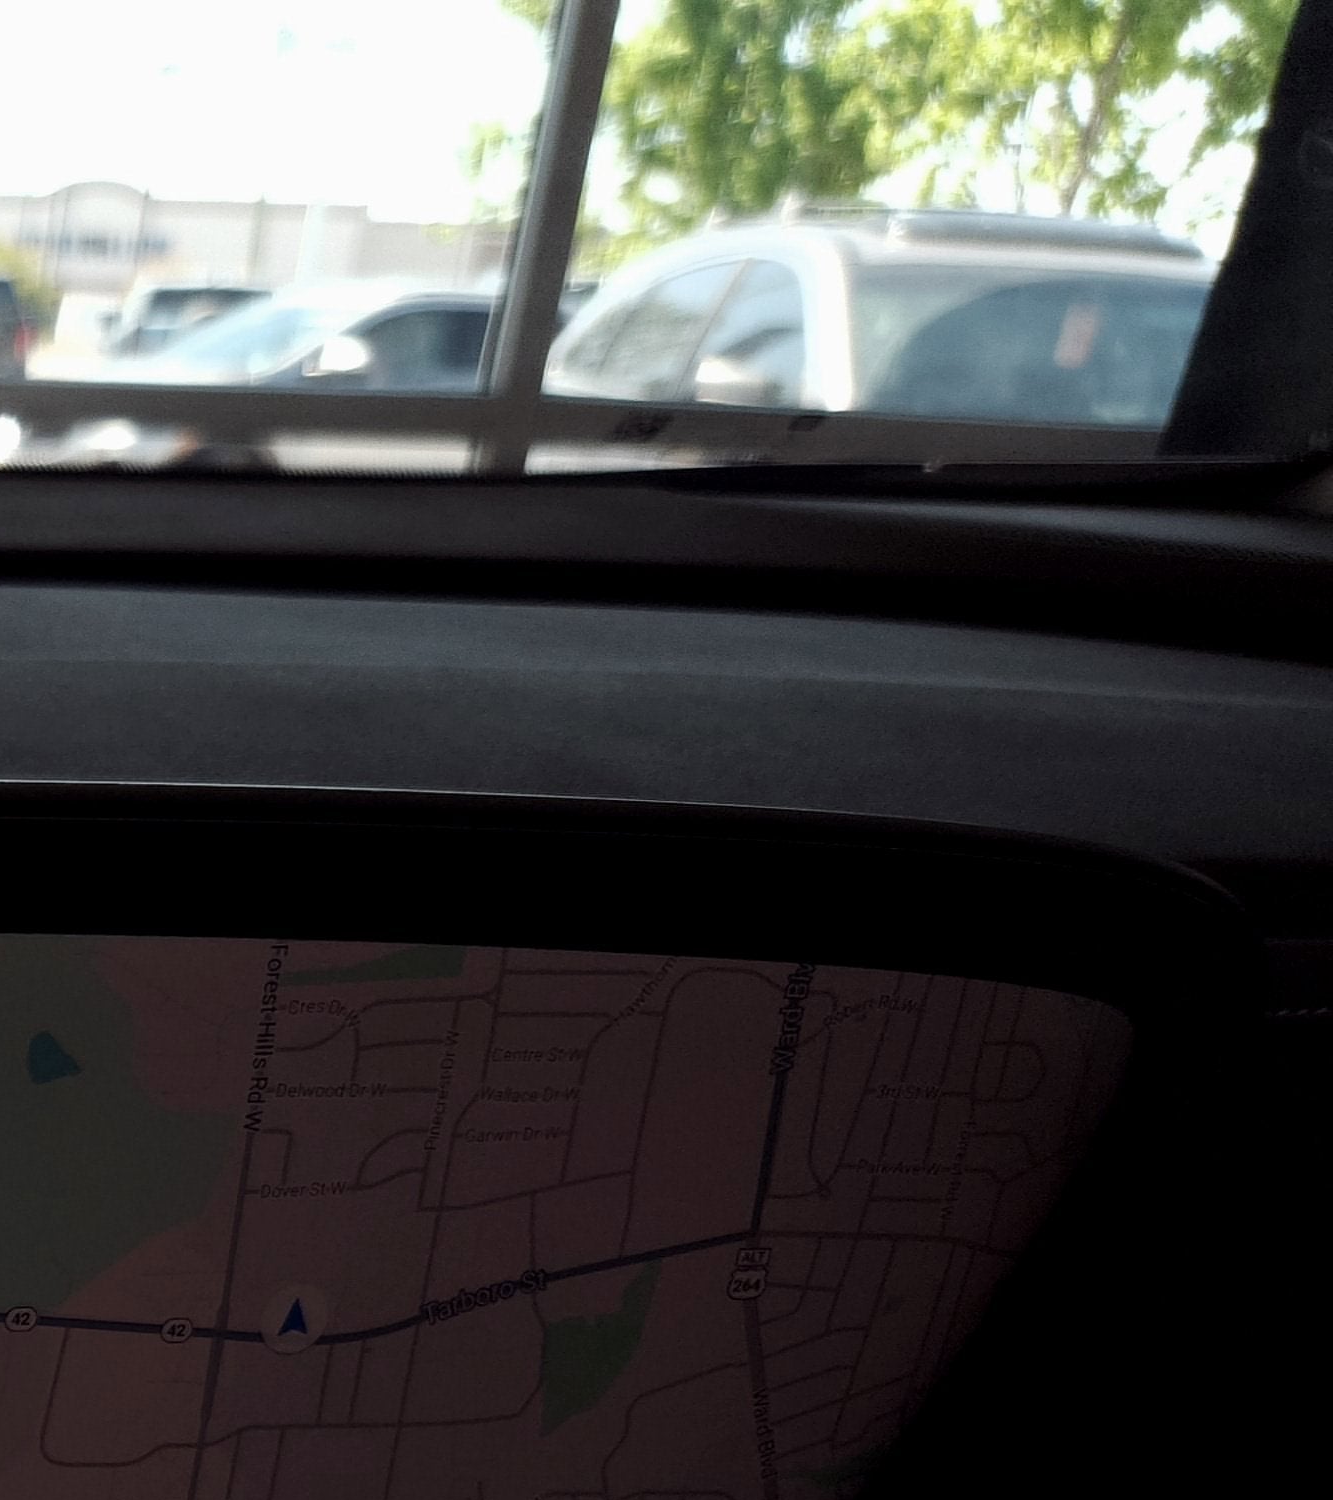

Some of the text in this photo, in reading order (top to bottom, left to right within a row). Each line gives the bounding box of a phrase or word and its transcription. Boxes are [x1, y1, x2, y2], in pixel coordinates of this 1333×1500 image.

[243, 943, 290, 1133] Forest Hills Rd W
[769, 1006, 805, 1075] Ward
[275, 1082, 345, 1098] Delwood
[424, 1073, 452, 1150] Pinecrest
[260, 1185, 306, 1199] Dover
[420, 1269, 547, 1325] Tarboro St
[733, 1278, 761, 1293] 264
[12, 1311, 31, 1326] 42
[167, 1324, 186, 1338] 42
[752, 1387, 774, 1437] Ward
